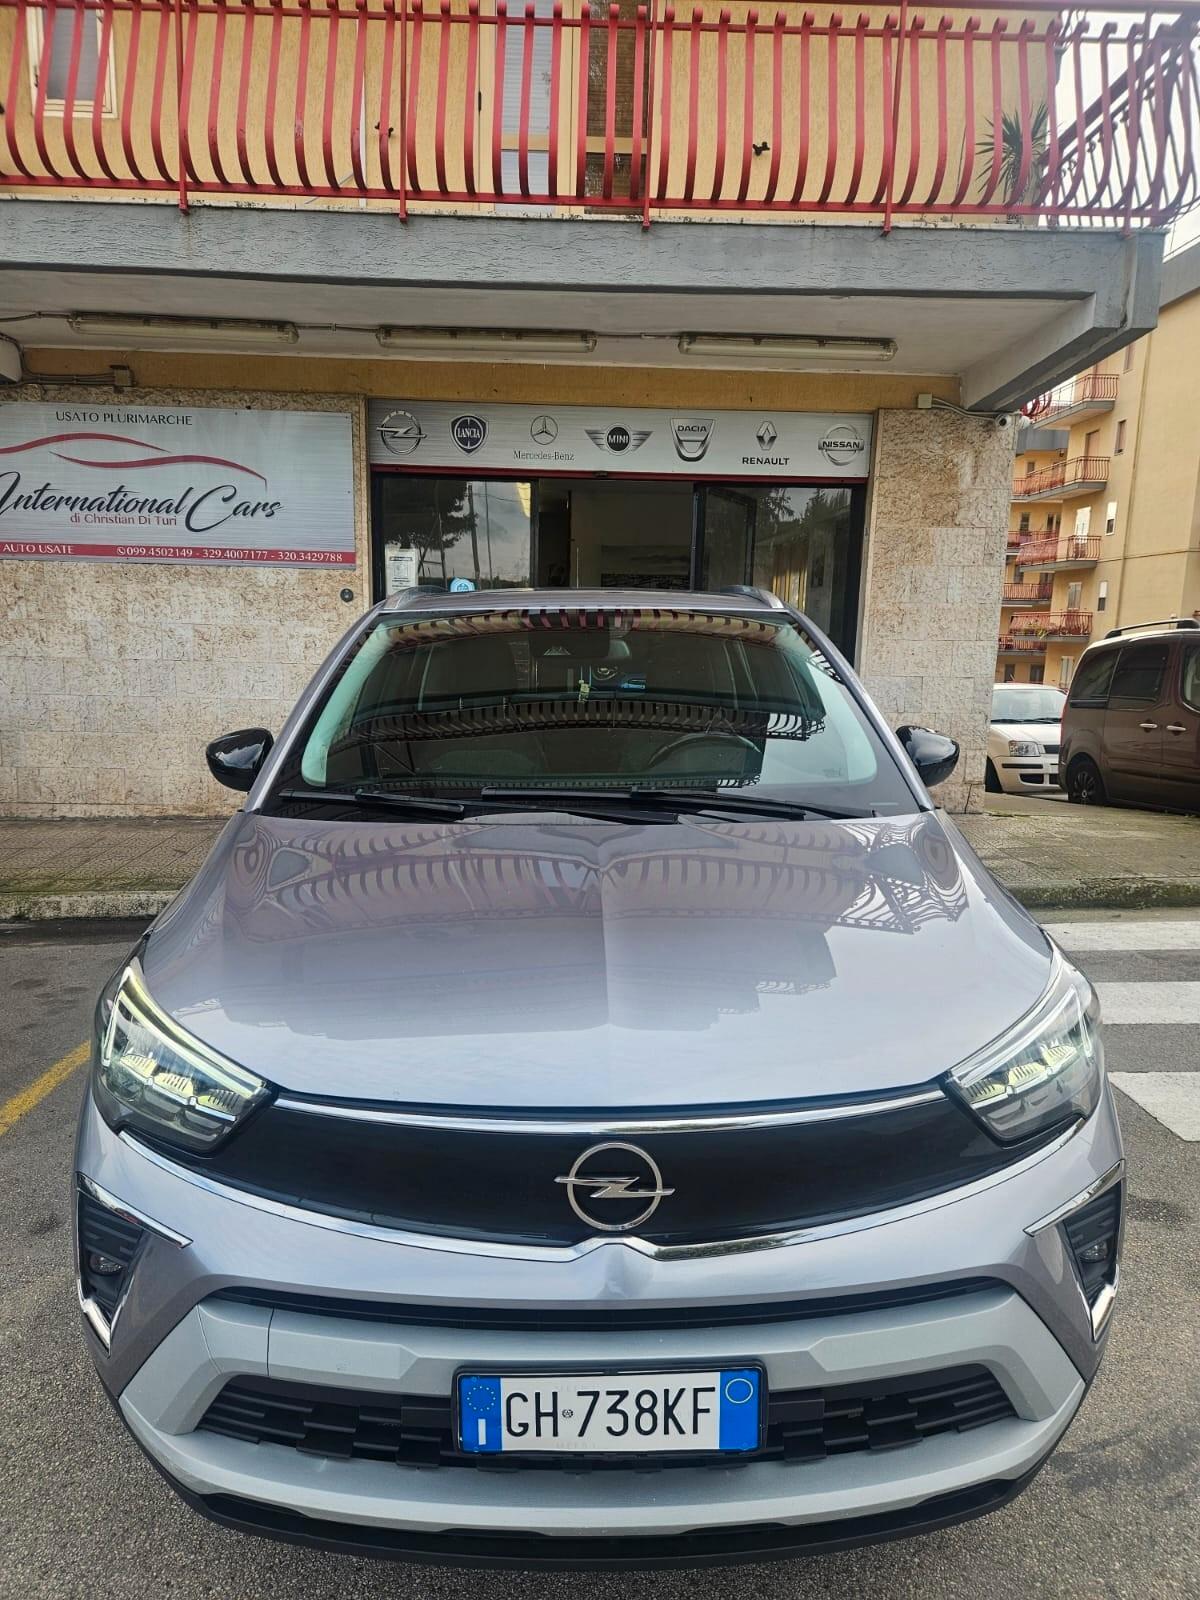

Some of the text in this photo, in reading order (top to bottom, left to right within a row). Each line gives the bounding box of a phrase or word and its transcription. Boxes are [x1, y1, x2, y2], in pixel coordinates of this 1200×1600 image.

[55, 411, 193, 426] USATO PLURIMARCHE
[677, 424, 707, 433] DACIA
[456, 430, 481, 440] LANCIA
[608, 435, 629, 445] MINI
[822, 440, 860, 450] NISSAN
[513, 451, 574, 461] Mercedes-Benz
[742, 457, 790, 466] RENAULT
[0, 471, 282, 533] International Cars
[70, 513, 177, 526] di Christian Di Turi
[3, 543, 37, 553] AUTO
[39, 545, 73, 555] USATE
[127, 546, 193, 557] 099.4502149
[202, 549, 268, 560] 329.4007177
[277, 552, 343, 563] 320.3429788
[506, 1391, 559, 1437] GH
[577, 1386, 716, 1438] 738KF
